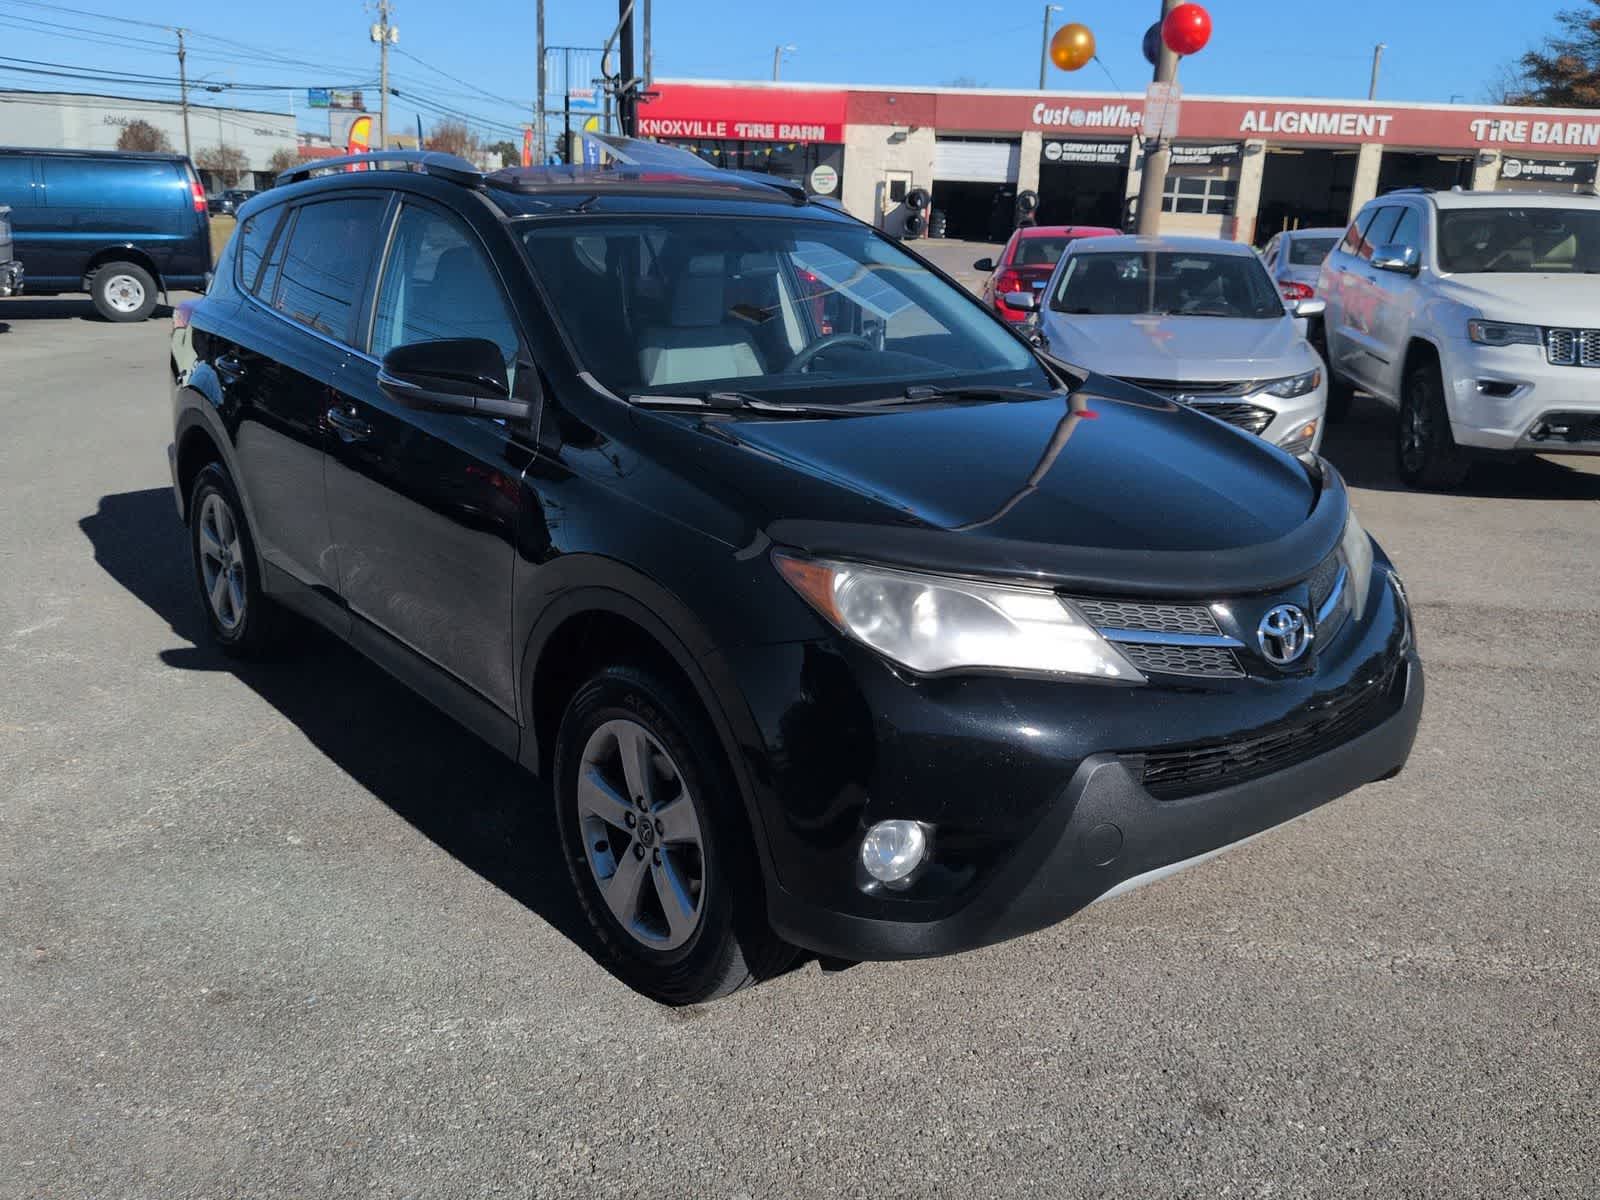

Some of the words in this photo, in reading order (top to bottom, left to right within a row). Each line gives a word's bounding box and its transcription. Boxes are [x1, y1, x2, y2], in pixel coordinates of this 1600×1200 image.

[1032, 103, 1145, 128] CustomWhe
[1239, 109, 1393, 137] ALIGNMENT
[638, 119, 726, 137] KNOXVILLE
[778, 123, 825, 141] BARN
[1530, 121, 1600, 146] BARN
